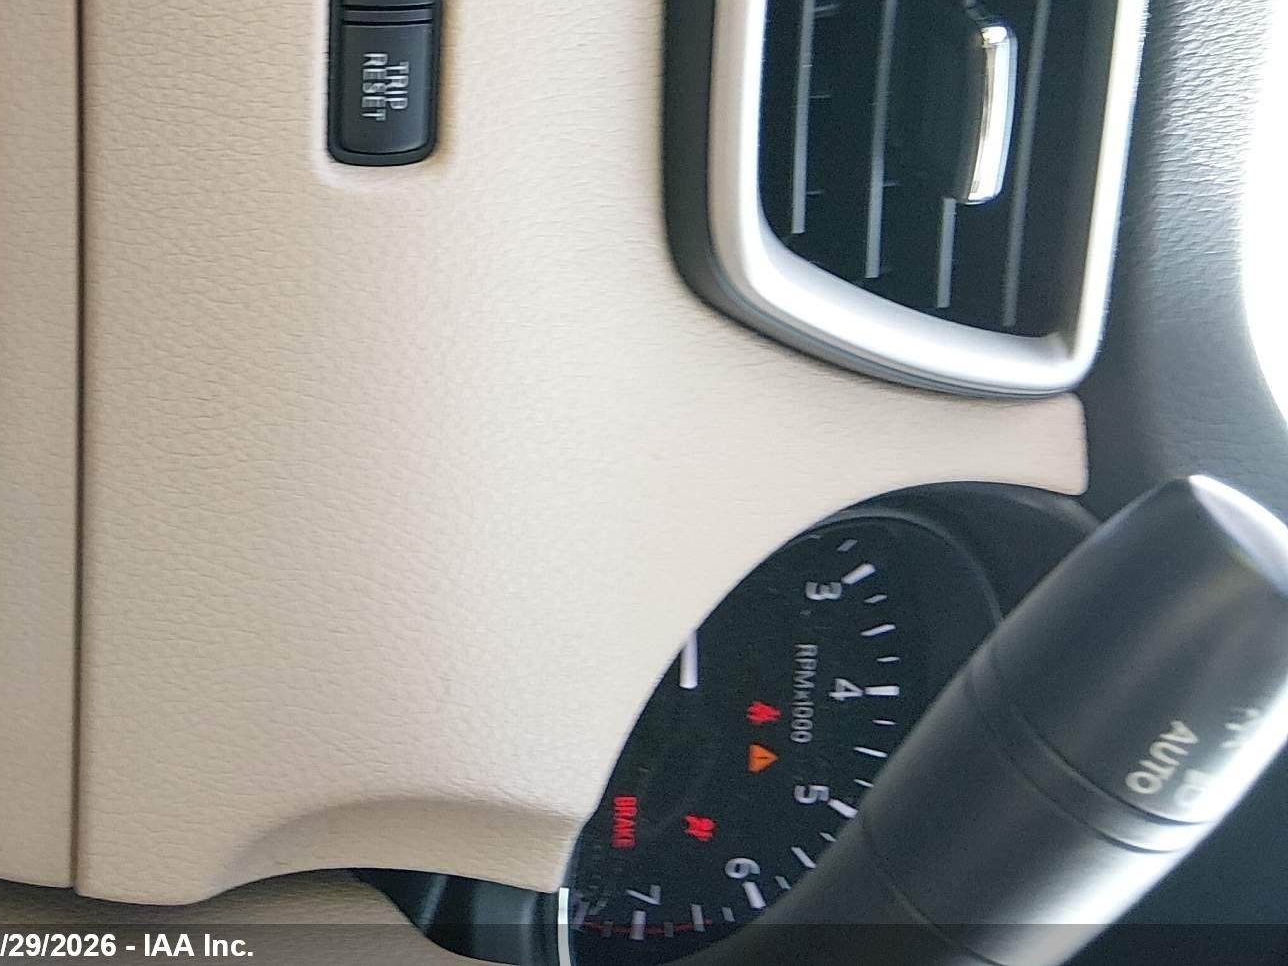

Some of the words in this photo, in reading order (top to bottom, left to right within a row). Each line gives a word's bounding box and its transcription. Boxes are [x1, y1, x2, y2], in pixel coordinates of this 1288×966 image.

[362, 53, 388, 120] RESET
[384, 61, 410, 109] TRIP
[804, 581, 843, 601] 3
[828, 677, 863, 701] 4
[1125, 720, 1199, 795] AUTO
[793, 784, 830, 805] 5
[612, 795, 638, 849] BRAKE
[724, 857, 761, 879] 6
[625, 884, 662, 906] 7
